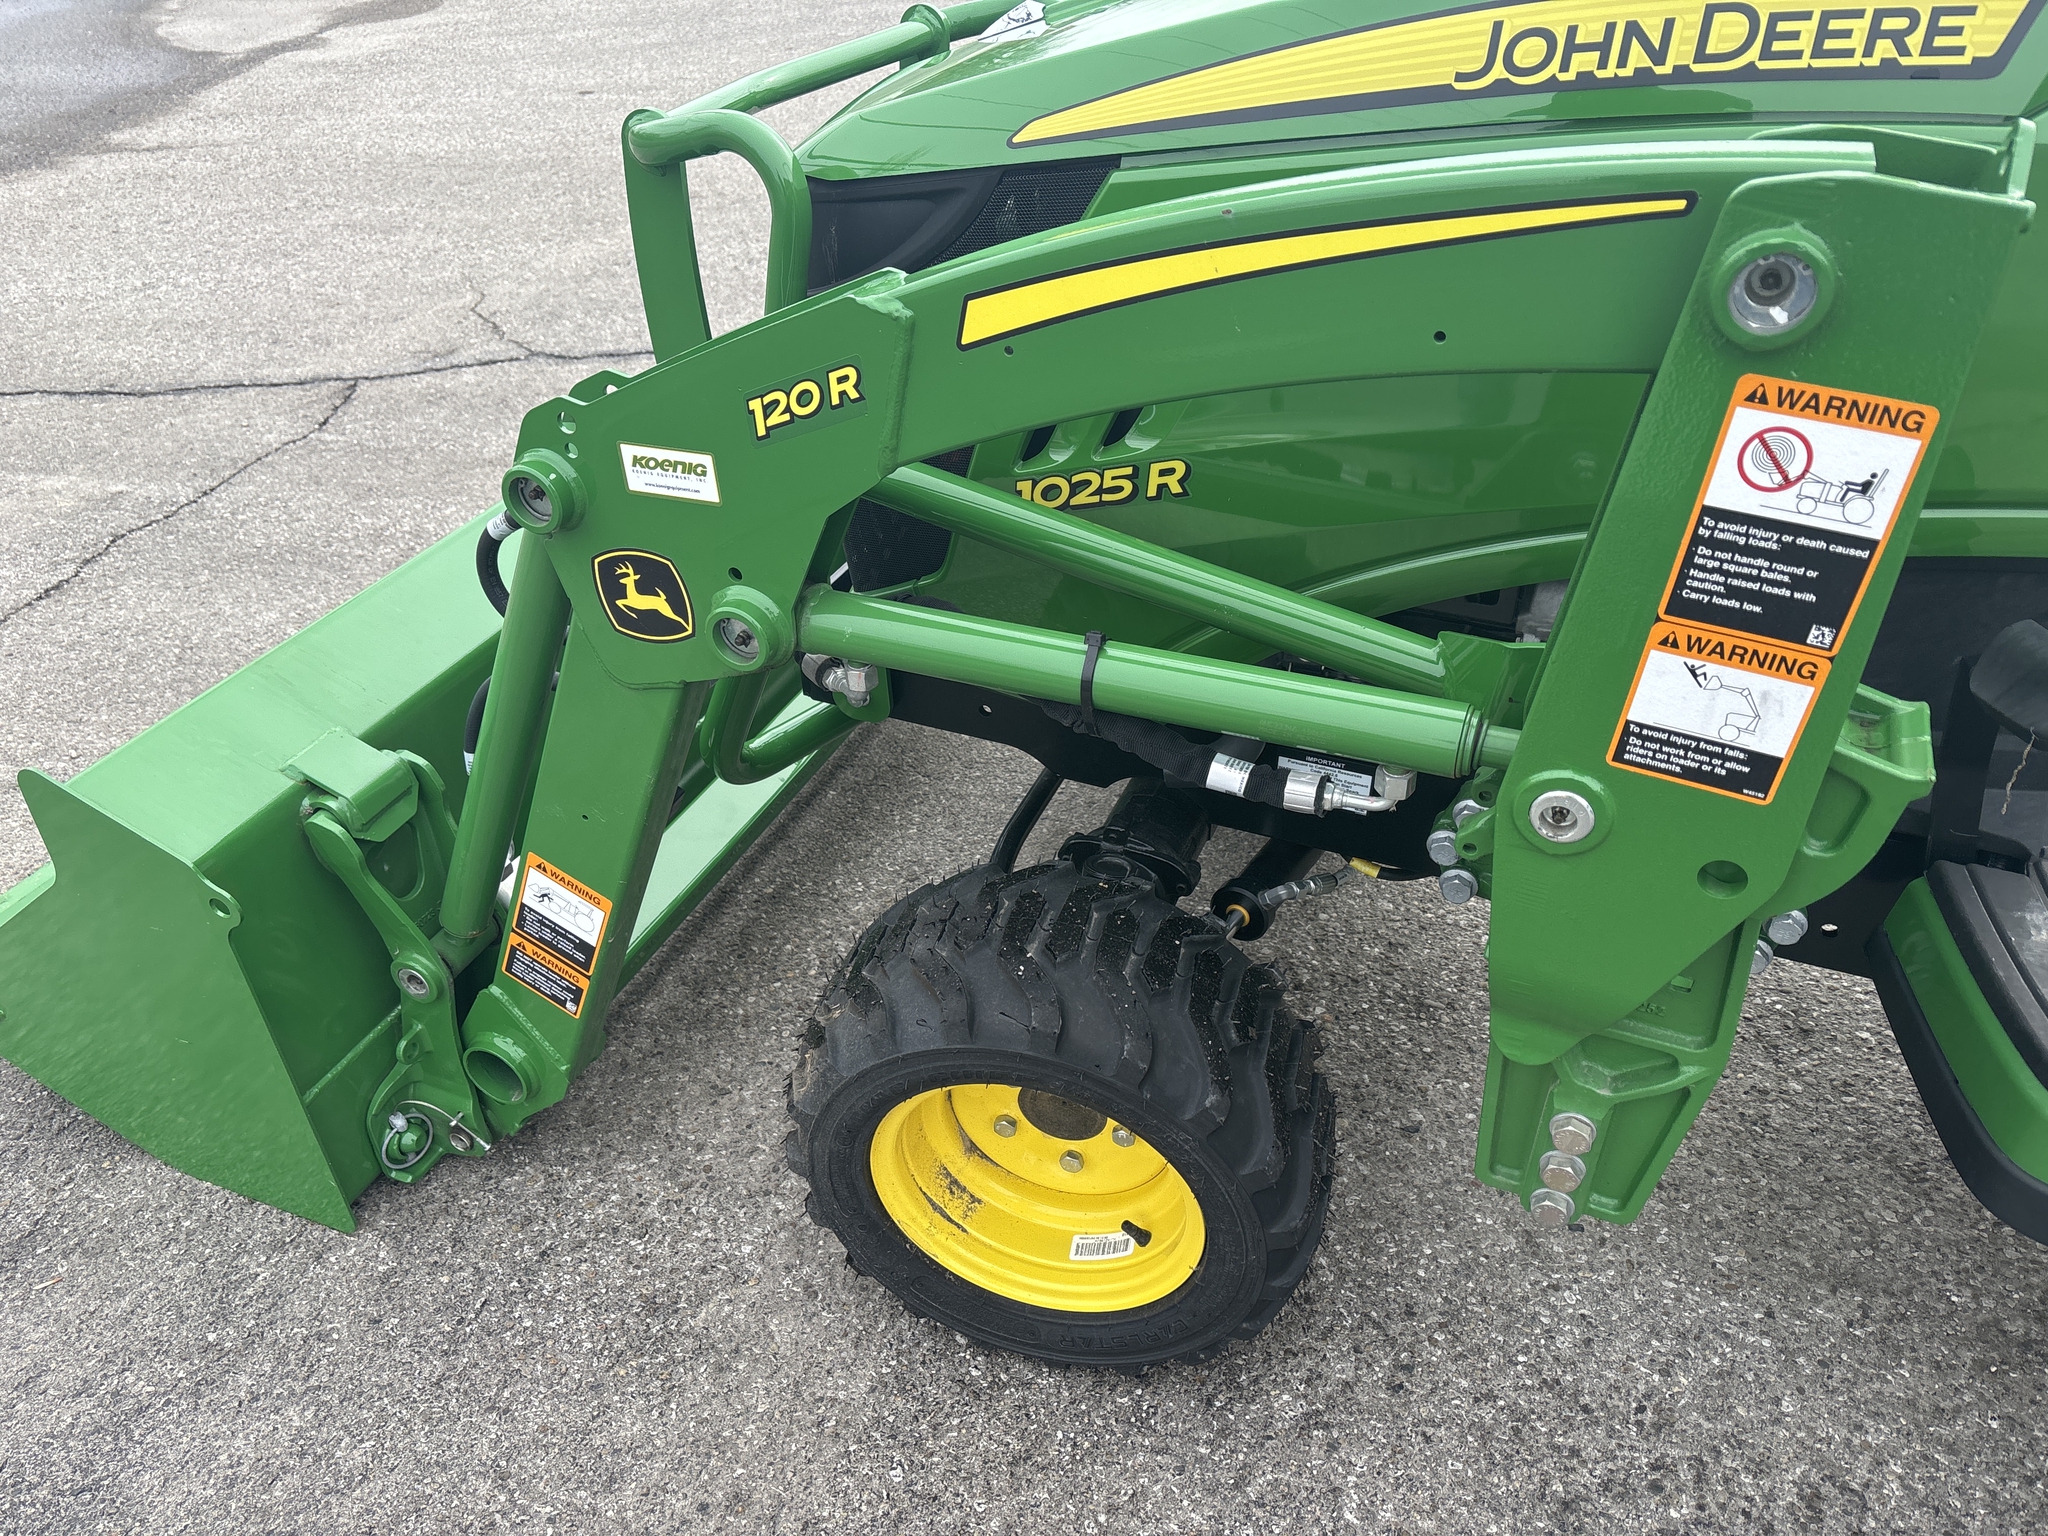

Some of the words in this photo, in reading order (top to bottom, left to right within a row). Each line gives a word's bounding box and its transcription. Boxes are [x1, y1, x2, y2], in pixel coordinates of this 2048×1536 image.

[1452, 16, 1677, 90] JOHN
[1690, 2, 1979, 70] DEERE
[747, 379, 824, 440] 120
[827, 365, 865, 409] R
[1777, 386, 1927, 433] WARNING
[1016, 465, 1139, 510] 1025
[1146, 459, 1191, 499] R
[1698, 526, 1711, 540] by
[1713, 530, 1746, 545] falling
[1748, 536, 1781, 550] loads:
[1702, 516, 1715, 527] To
[1717, 520, 1747, 534] avoid
[1749, 526, 1779, 542] injury
[1782, 533, 1794, 542] or
[1796, 536, 1827, 550] death
[1829, 543, 1870, 559] caused
[1694, 555, 1720, 570] large
[1722, 561, 1758, 577] square
[1760, 567, 1791, 583] bales.
[1697, 545, 1712, 556] Do
[1714, 550, 1732, 561] not
[1734, 554, 1770, 568] handle
[1772, 560, 1804, 575] round
[1806, 569, 1819, 579] or
[1682, 589, 1710, 603] Carry
[1712, 593, 1740, 608] loads
[1743, 601, 1763, 614] low.
[1686, 578, 1726, 594] caution.
[1689, 568, 1725, 583] Handle
[1727, 575, 1759, 590] raised
[1762, 582, 1791, 597] loads
[1794, 589, 1816, 602] with
[1686, 634, 1819, 681] WARNING
[1629, 723, 1639, 733] To
[1641, 727, 1668, 740] avoid
[1670, 734, 1697, 748] injury
[1699, 741, 1722, 753] from
[1724, 746, 1749, 760] falls:
[1629, 736, 1642, 746] Do
[1644, 740, 1660, 750] not
[1662, 744, 1685, 757] work
[1687, 750, 1711, 762] from
[1712, 757, 1723, 765] or
[1724, 760, 1750, 774] allow
[1305, 755, 1346, 769] IMPORTANT
[1623, 752, 1683, 774] attachments.
[1626, 745, 1653, 757] riders
[1655, 752, 1667, 761] on
[1670, 755, 1700, 769] loader
[1702, 763, 1713, 772] or
[1714, 766, 1727, 776] its
[550, 869, 601, 906] WARNING
[532, 949, 579, 984] WARNING
